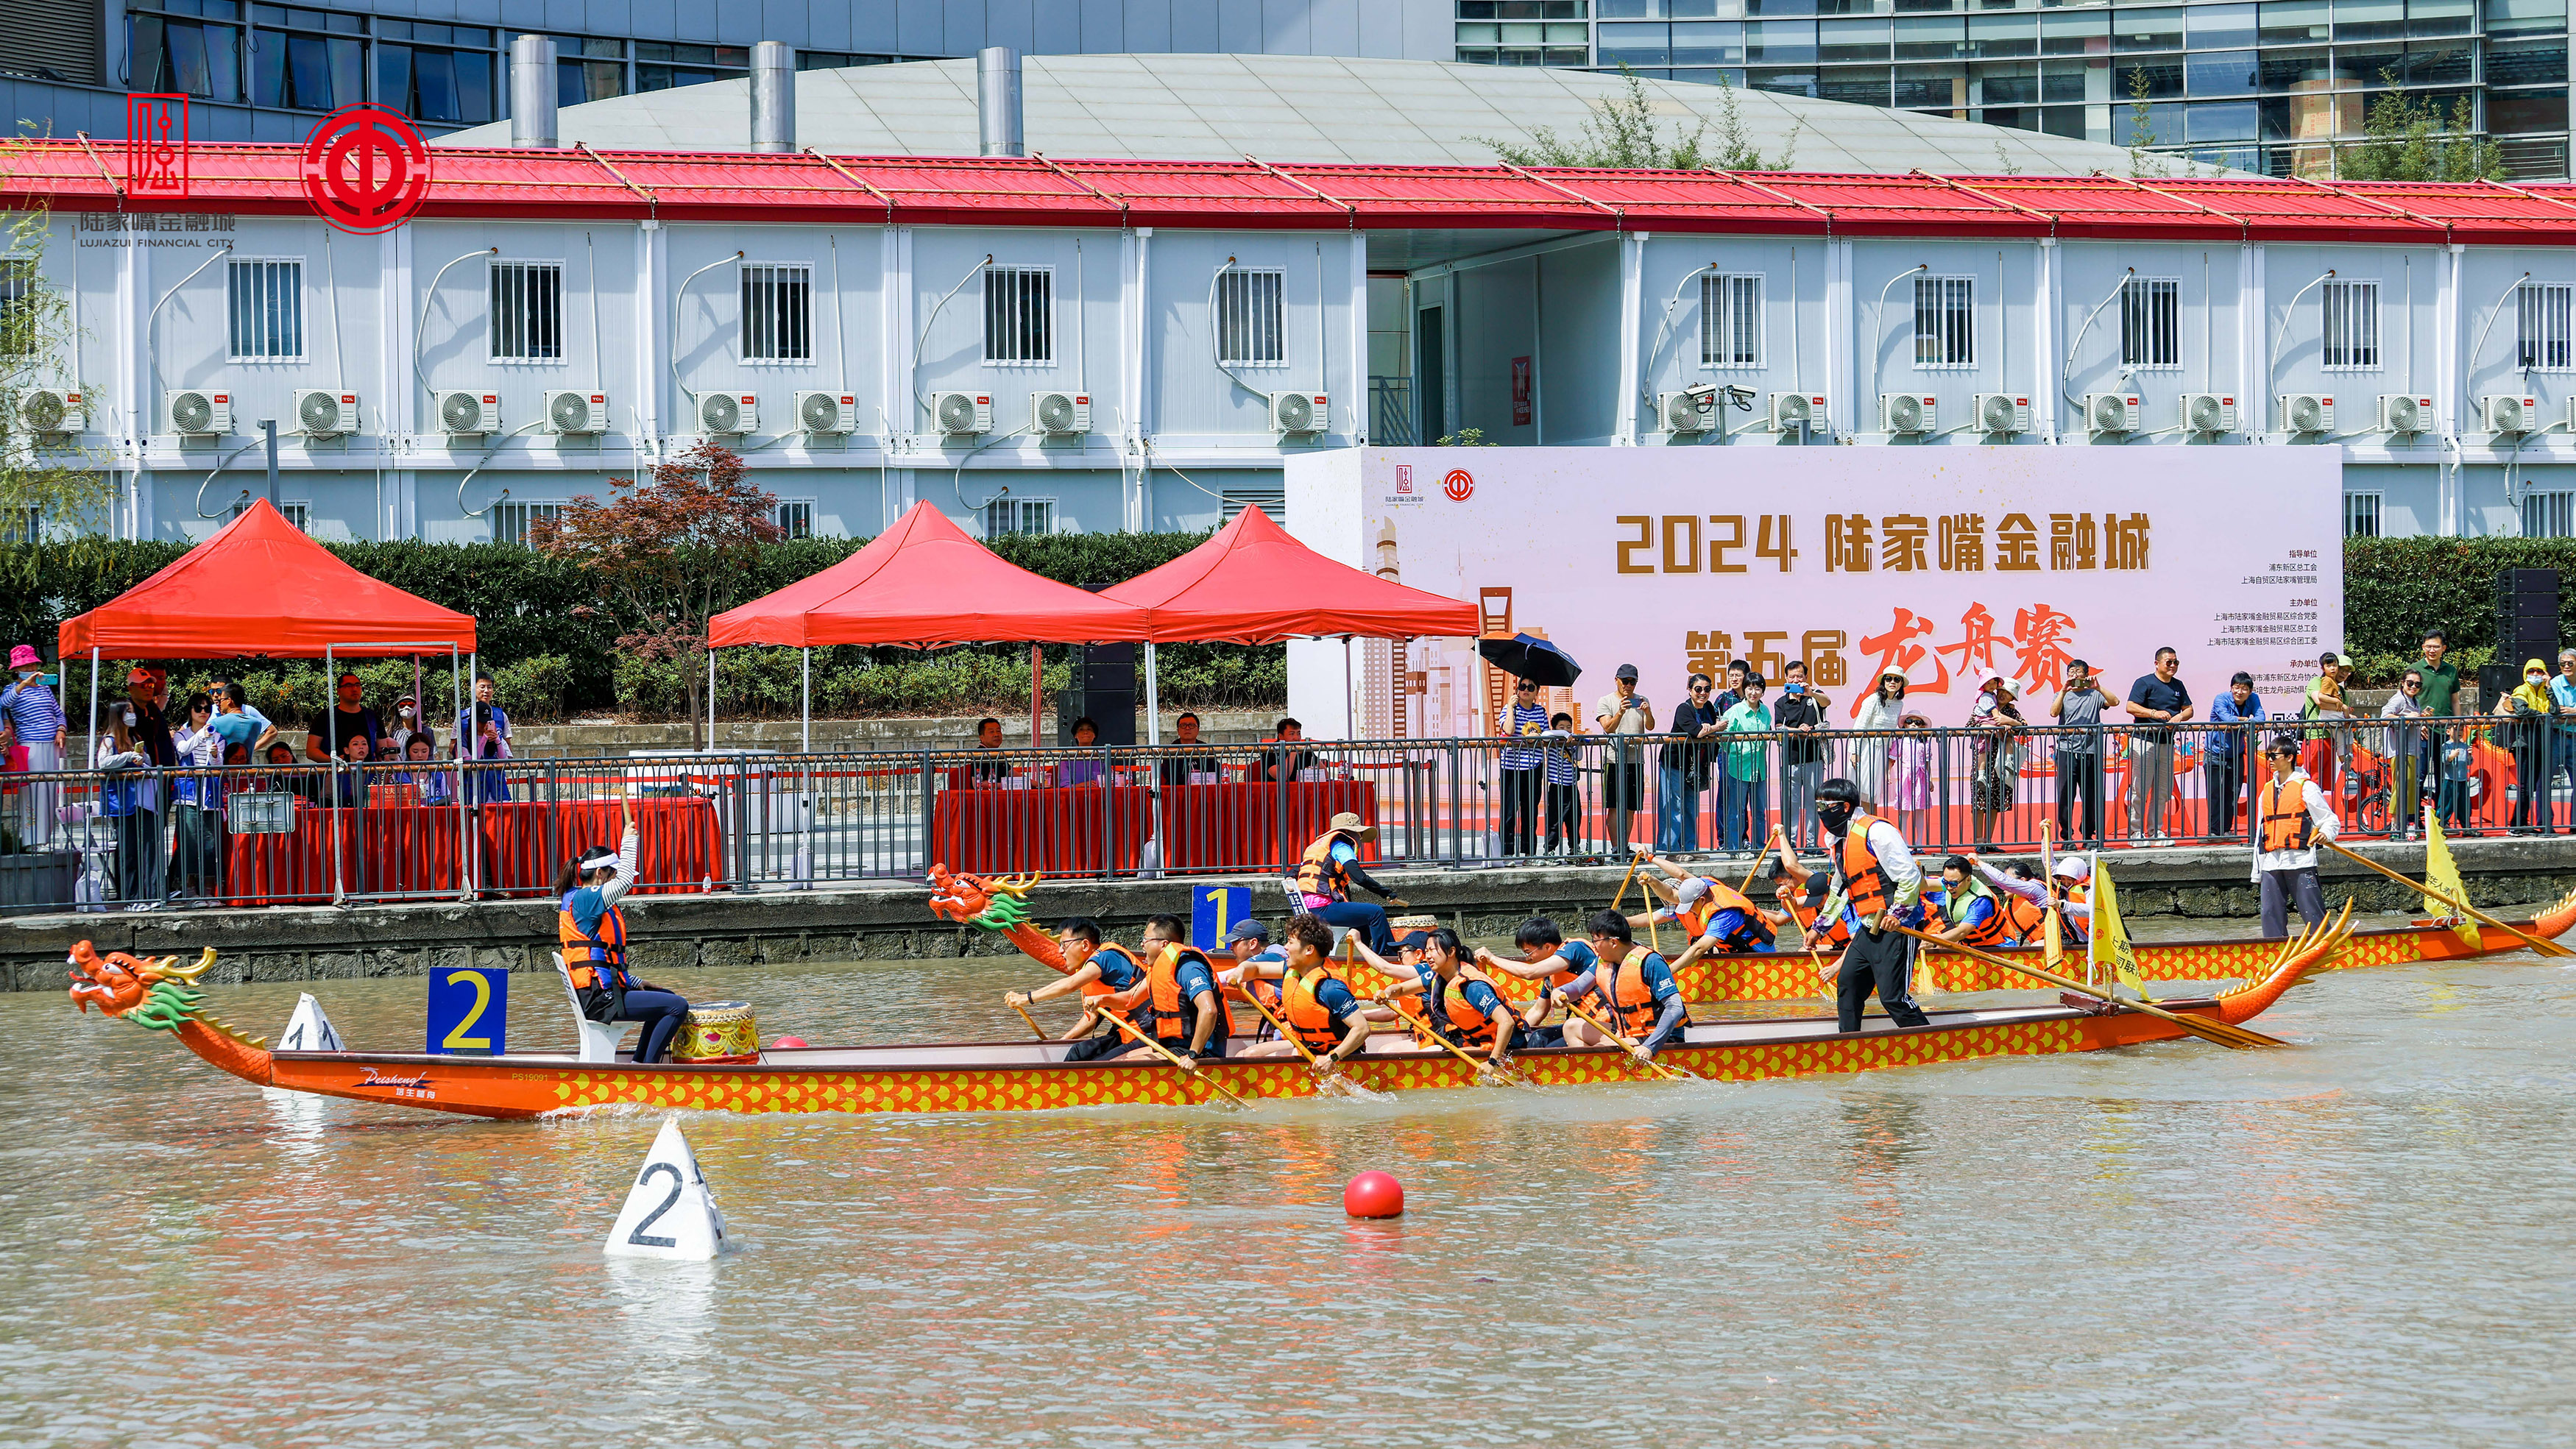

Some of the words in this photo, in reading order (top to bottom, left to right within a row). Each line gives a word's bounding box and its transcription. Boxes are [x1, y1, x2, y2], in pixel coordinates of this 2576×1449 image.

[1616, 514, 1798, 575] 2024
[1825, 512, 2151, 573] 陆家嘴金融城
[2289, 550, 2317, 558] 指导单位
[2268, 564, 2318, 572] 浦东新区总工会
[2241, 576, 2318, 584] 上海自贸区陆家嘴管理局
[2290, 598, 2318, 606] 主办单位
[2214, 612, 2318, 621] 上海市陆家嘴金融贸易区综合党委
[2221, 625, 2318, 634] 上海市陆家嘴金融贸易区总工会
[2207, 637, 2318, 646] 上海市陆家嘴金融贸易区综合团工委
[1685, 629, 1847, 690] 第五届
[1850, 601, 2104, 720] 龙舟赛
[2290, 659, 2318, 668] 承办单位
[2252, 685, 2308, 694] 培生龙舟运动俱
[1206, 888, 1228, 949] 1
[2112, 935, 2133, 957] 上期
[1189, 976, 1204, 986] SHFE
[1659, 977, 1672, 988] SHFE
[442, 970, 491, 1049] 2
[289, 1023, 304, 1051] 1
[359, 1066, 428, 1085] Peisheng
[512, 1073, 548, 1081] PS19091
[628, 1162, 683, 1248] 2
